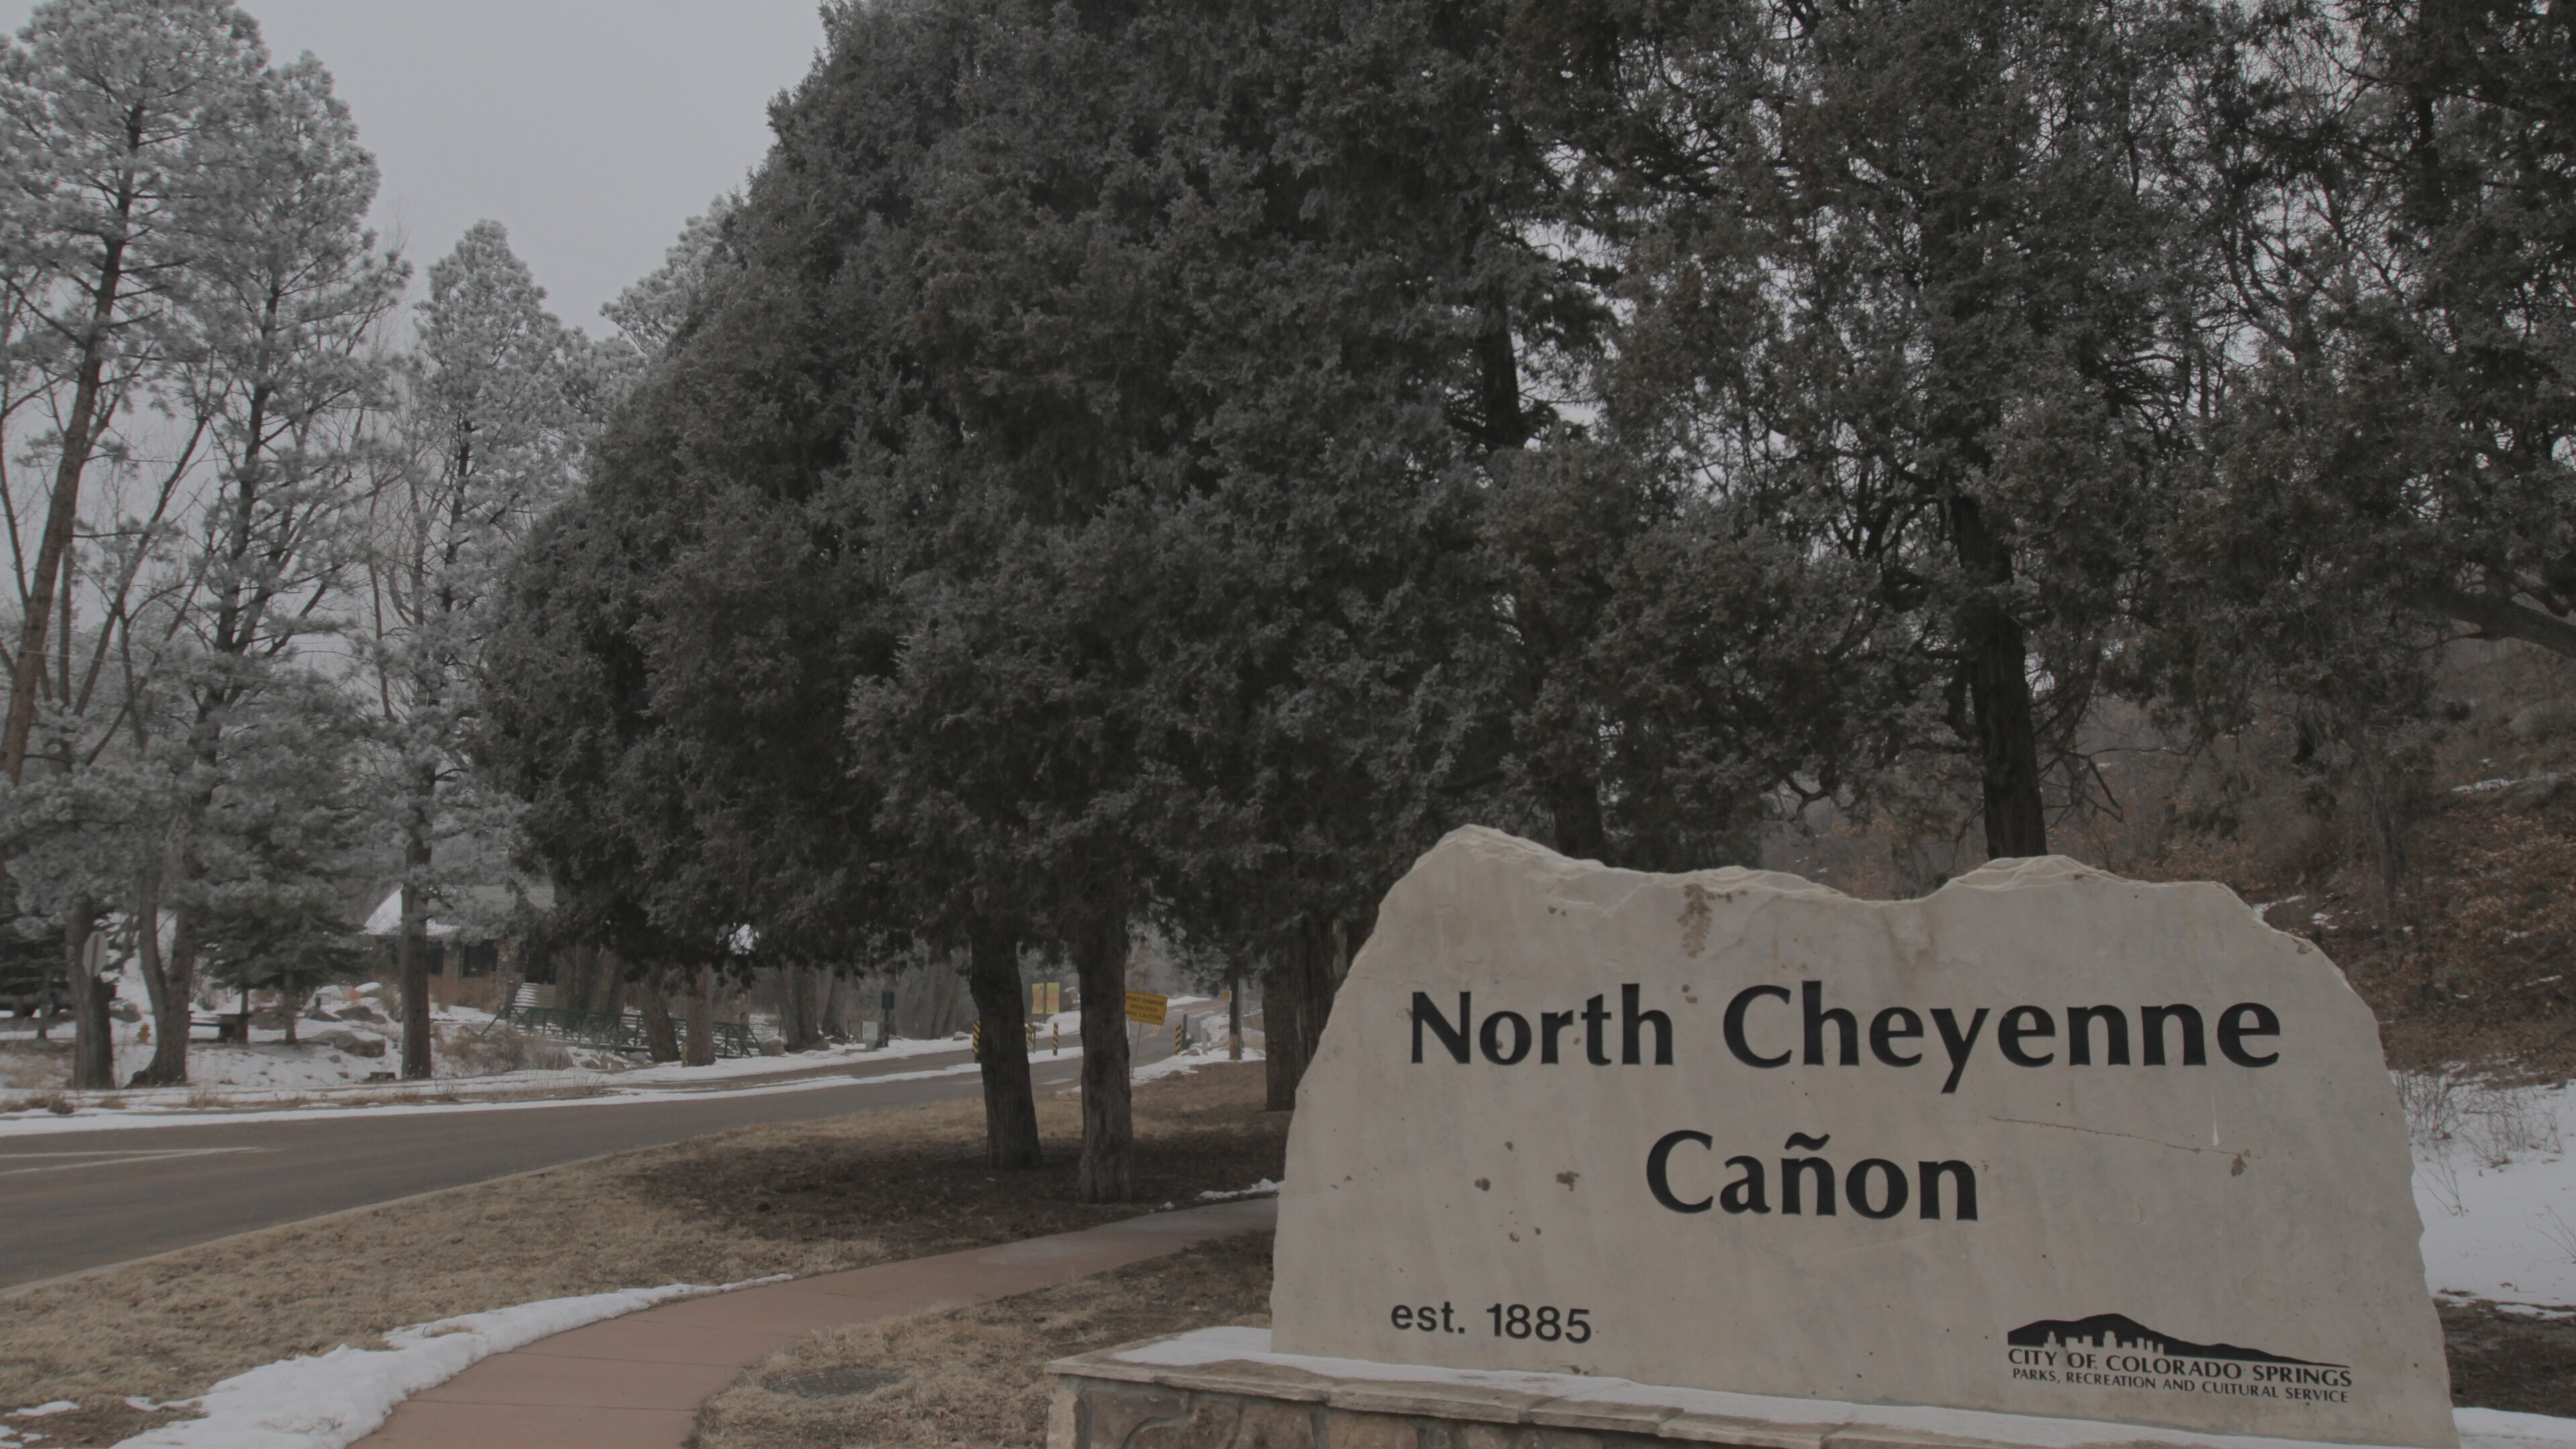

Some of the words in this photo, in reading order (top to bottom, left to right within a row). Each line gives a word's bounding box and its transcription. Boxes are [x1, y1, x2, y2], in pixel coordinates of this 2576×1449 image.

[1130, 1004, 1158, 1012] PROCEED
[1138, 1012, 1162, 1020] CAUTION
[1409, 983, 1673, 1066] North
[1723, 980, 2280, 1094] Cheyenne
[1646, 1130, 1978, 1221] Cañon
[1391, 1302, 1465, 1334] est.
[1487, 1303, 1591, 1344] 1885
[2008, 1348, 2057, 1366] CITY
[2106, 1355, 2243, 1379] COLORADO
[2252, 1364, 2352, 1387] SPRINGS
[2013, 1368, 2061, 1385] PARKS,
[2066, 1371, 2157, 1389] RECREATION
[2164, 1379, 2195, 1392] AND
[2202, 1381, 2277, 1398] CULTURAL
[2285, 1387, 2347, 1403] SERVICE
